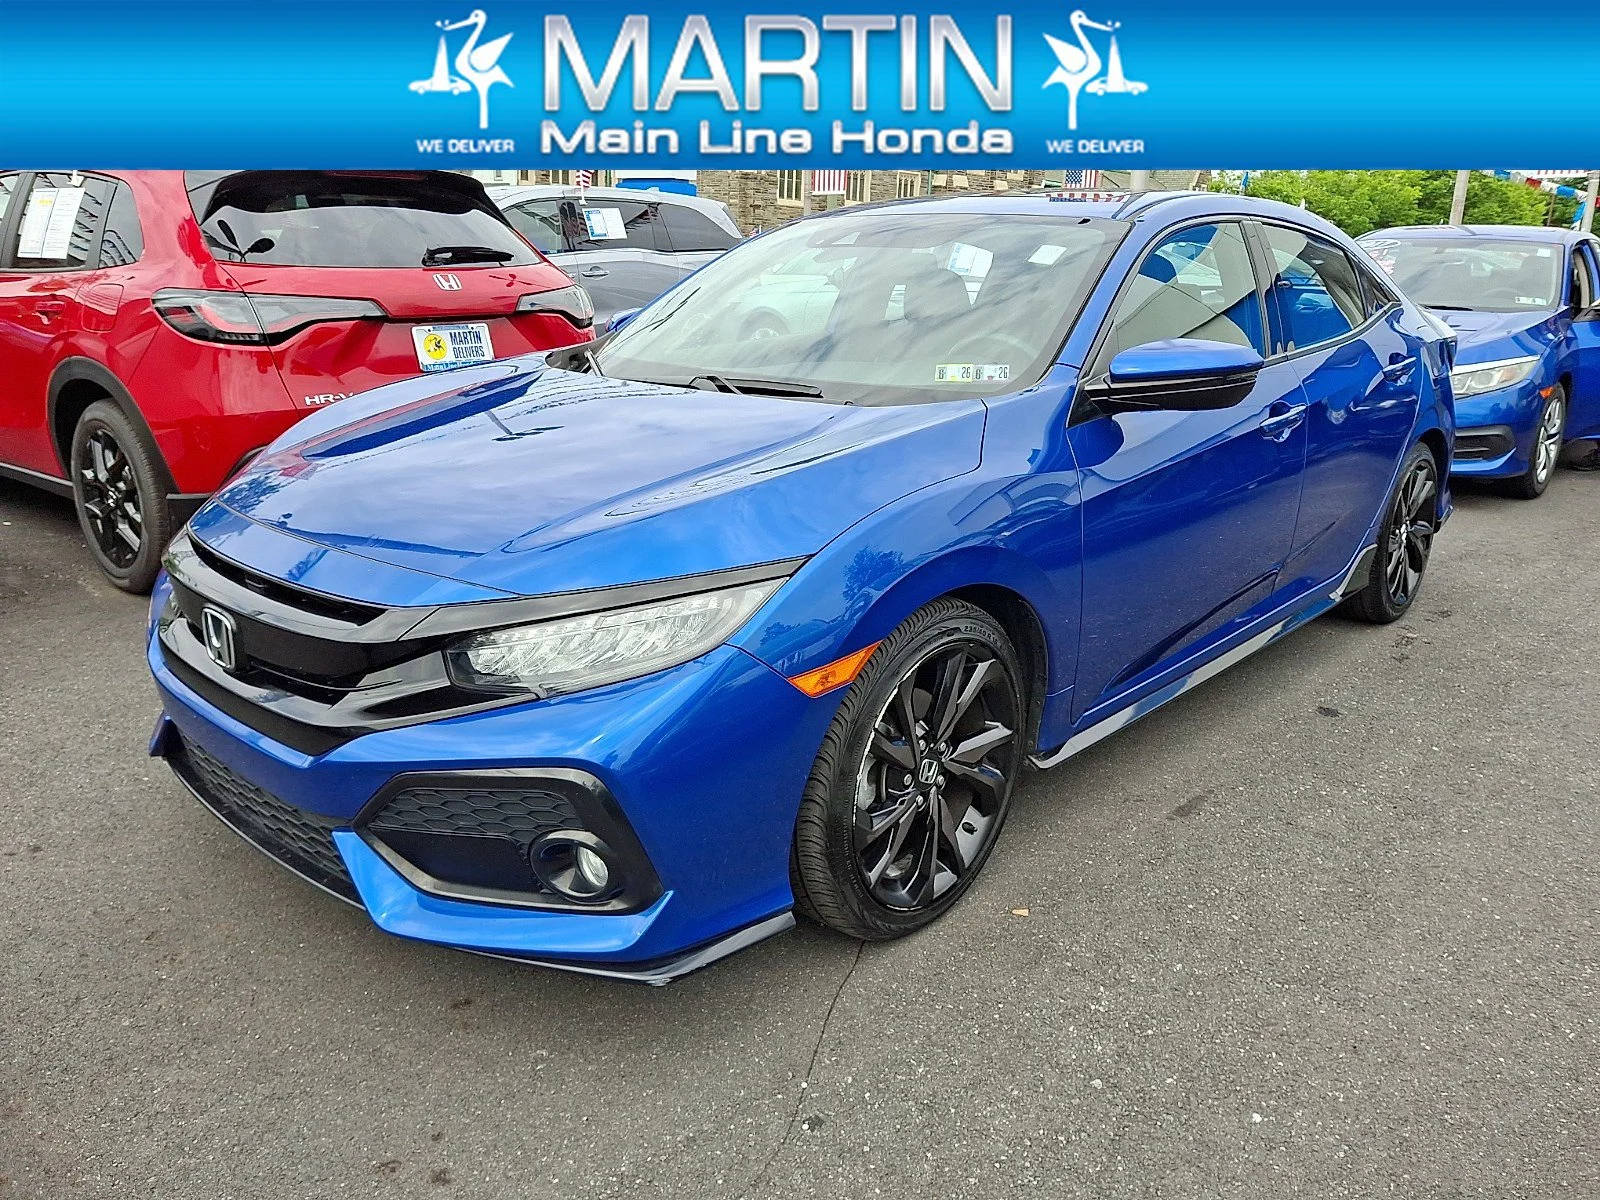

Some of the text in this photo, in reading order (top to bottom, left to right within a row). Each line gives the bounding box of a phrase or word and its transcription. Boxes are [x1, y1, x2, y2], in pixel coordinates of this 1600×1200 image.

[449, 330, 483, 346] MARTIN
[452, 345, 486, 359] DELIVERS
[961, 366, 971, 379] 26
[998, 366, 1008, 379] 26
